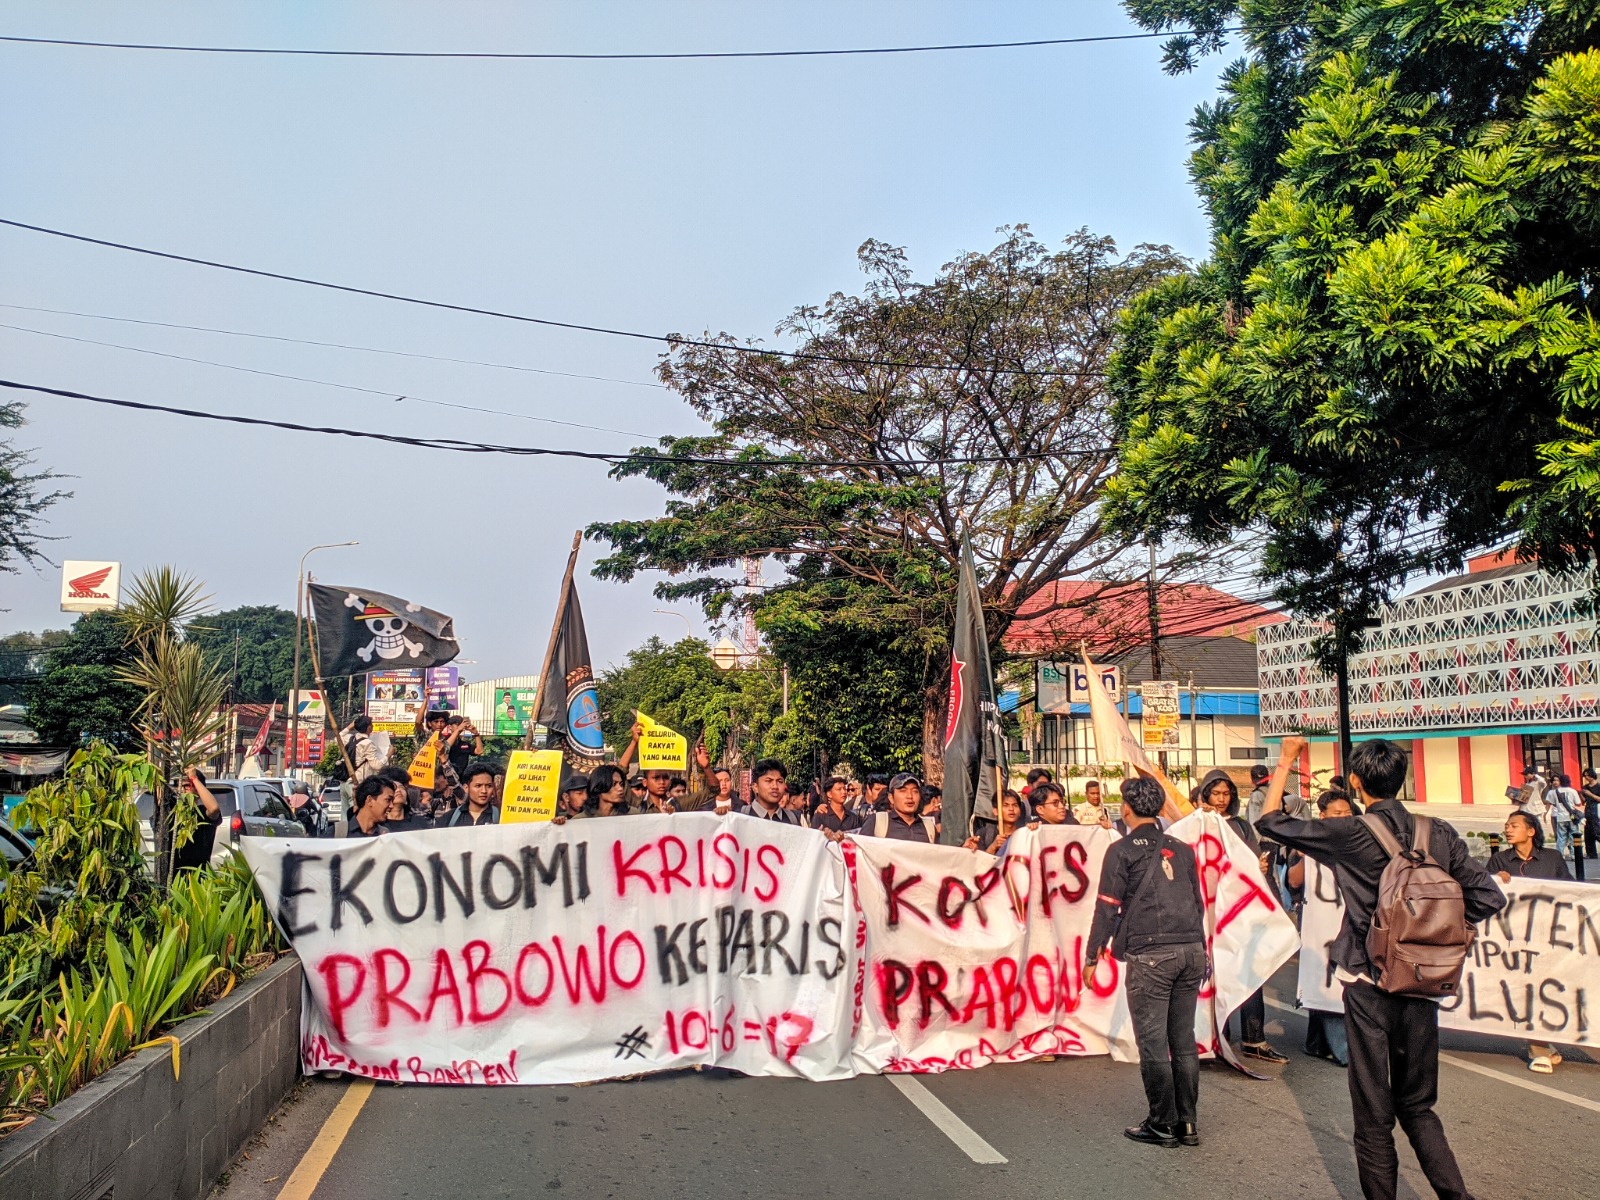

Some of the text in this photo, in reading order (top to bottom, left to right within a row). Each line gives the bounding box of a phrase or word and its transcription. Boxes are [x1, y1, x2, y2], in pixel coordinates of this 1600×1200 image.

[68, 591, 110, 599] HONDA
[1074, 667, 1116, 691] bn
[647, 730, 677, 738] SELURUH
[516, 795, 542, 803] BANYAK
[518, 806, 531, 814] DAN
[278, 842, 591, 941] EKONOMI
[612, 833, 785, 903] KRISIS
[317, 925, 646, 1043] PRABOWO
[407, 1050, 518, 1084] BANTEN
